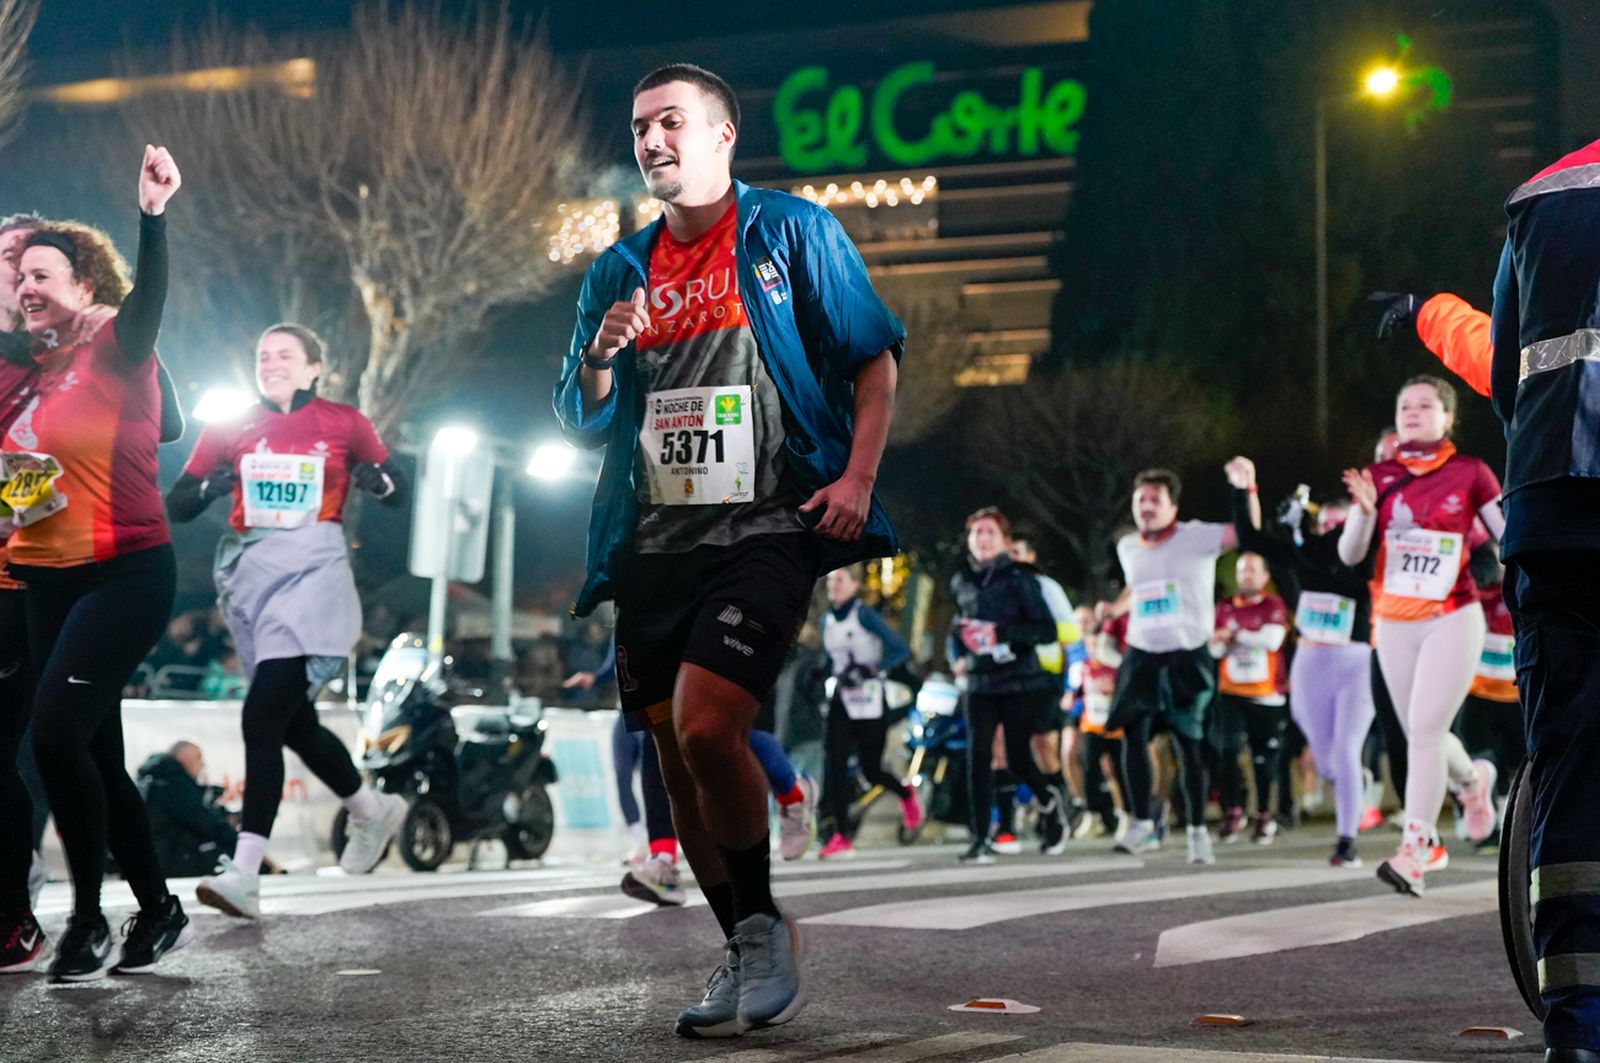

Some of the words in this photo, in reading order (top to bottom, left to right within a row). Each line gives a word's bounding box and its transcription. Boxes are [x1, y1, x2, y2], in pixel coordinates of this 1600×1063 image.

[773, 65, 867, 171] El
[871, 60, 1087, 164] Corte
[663, 401, 689, 414] NOCHE
[690, 400, 704, 412] DE
[654, 417, 670, 430] SAN
[671, 413, 704, 428] ANTÓN
[660, 429, 724, 465] 5371
[671, 466, 708, 475] ANTONINO
[256, 481, 308, 503] 12197
[1402, 553, 1440, 575] 2172
